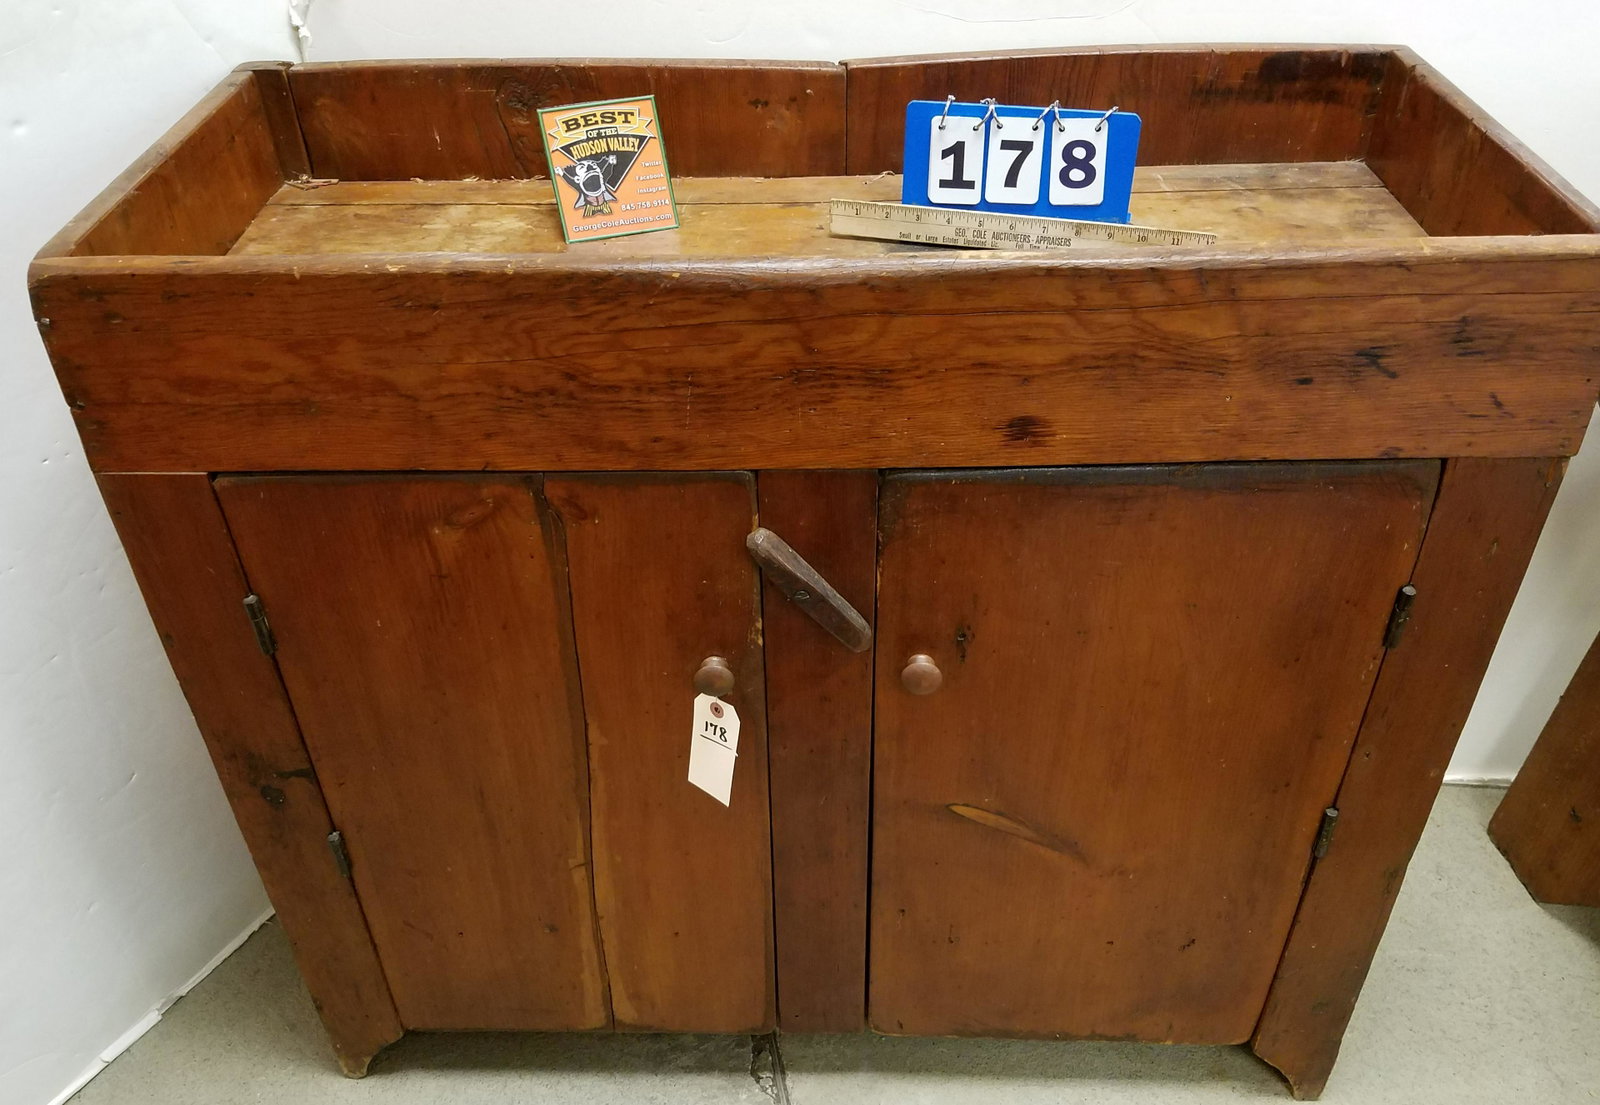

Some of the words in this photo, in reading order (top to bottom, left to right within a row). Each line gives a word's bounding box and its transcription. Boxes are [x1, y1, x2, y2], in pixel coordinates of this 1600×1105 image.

[562, 112, 634, 132] BEST
[587, 129, 598, 138] OF
[570, 138, 607, 160] HUDSON
[608, 138, 640, 152] VALLEY
[636, 173, 665, 181] Facebook
[637, 186, 667, 194] Instagram
[621, 199, 670, 211] 845.758.9114
[572, 213, 673, 232] GeorgeColeAuctions.com
[955, 228, 967, 238] GEO.
[972, 229, 987, 239] COLE
[942, 236, 959, 244] Estates
[1136, 234, 1146, 242] 10
[1171, 237, 1180, 245] 11
[705, 721, 728, 742] 178
